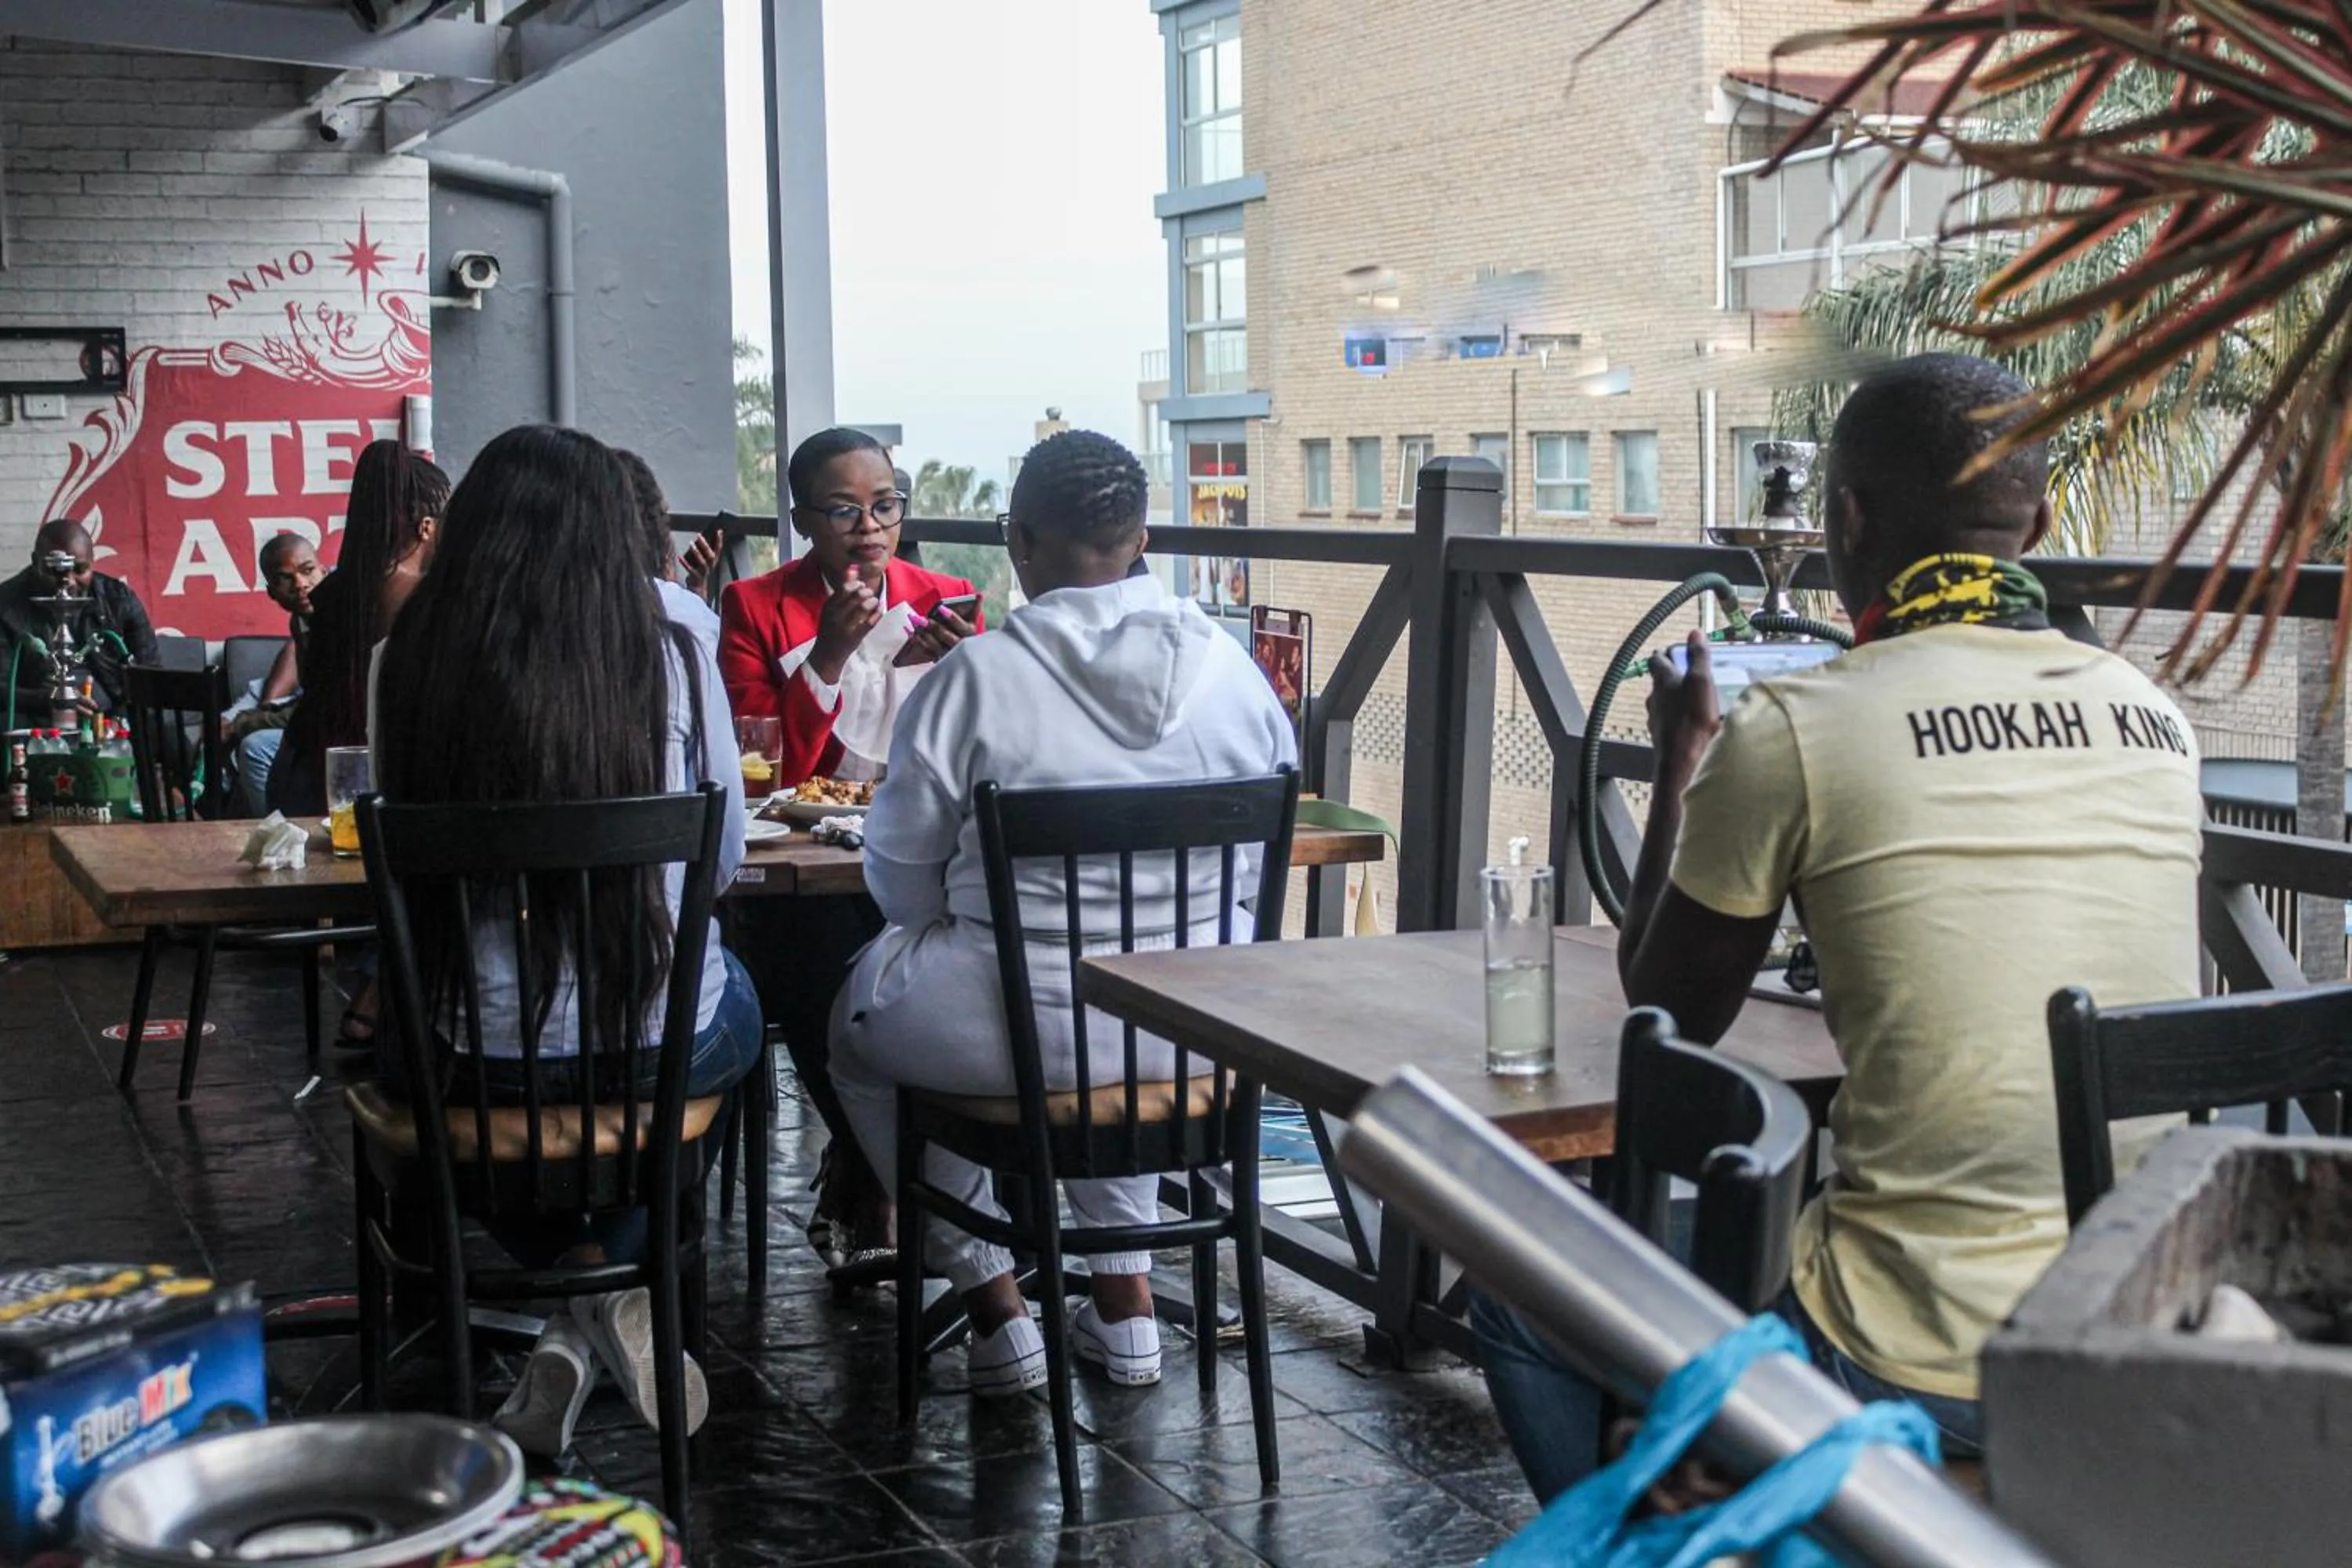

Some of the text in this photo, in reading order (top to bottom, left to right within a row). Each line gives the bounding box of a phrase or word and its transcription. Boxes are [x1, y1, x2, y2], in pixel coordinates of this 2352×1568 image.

[206, 250, 314, 320] ANNO
[162, 419, 401, 500] STE
[1907, 702, 2189, 758] HOOKAH KING
[32, 800, 113, 822] eineken
